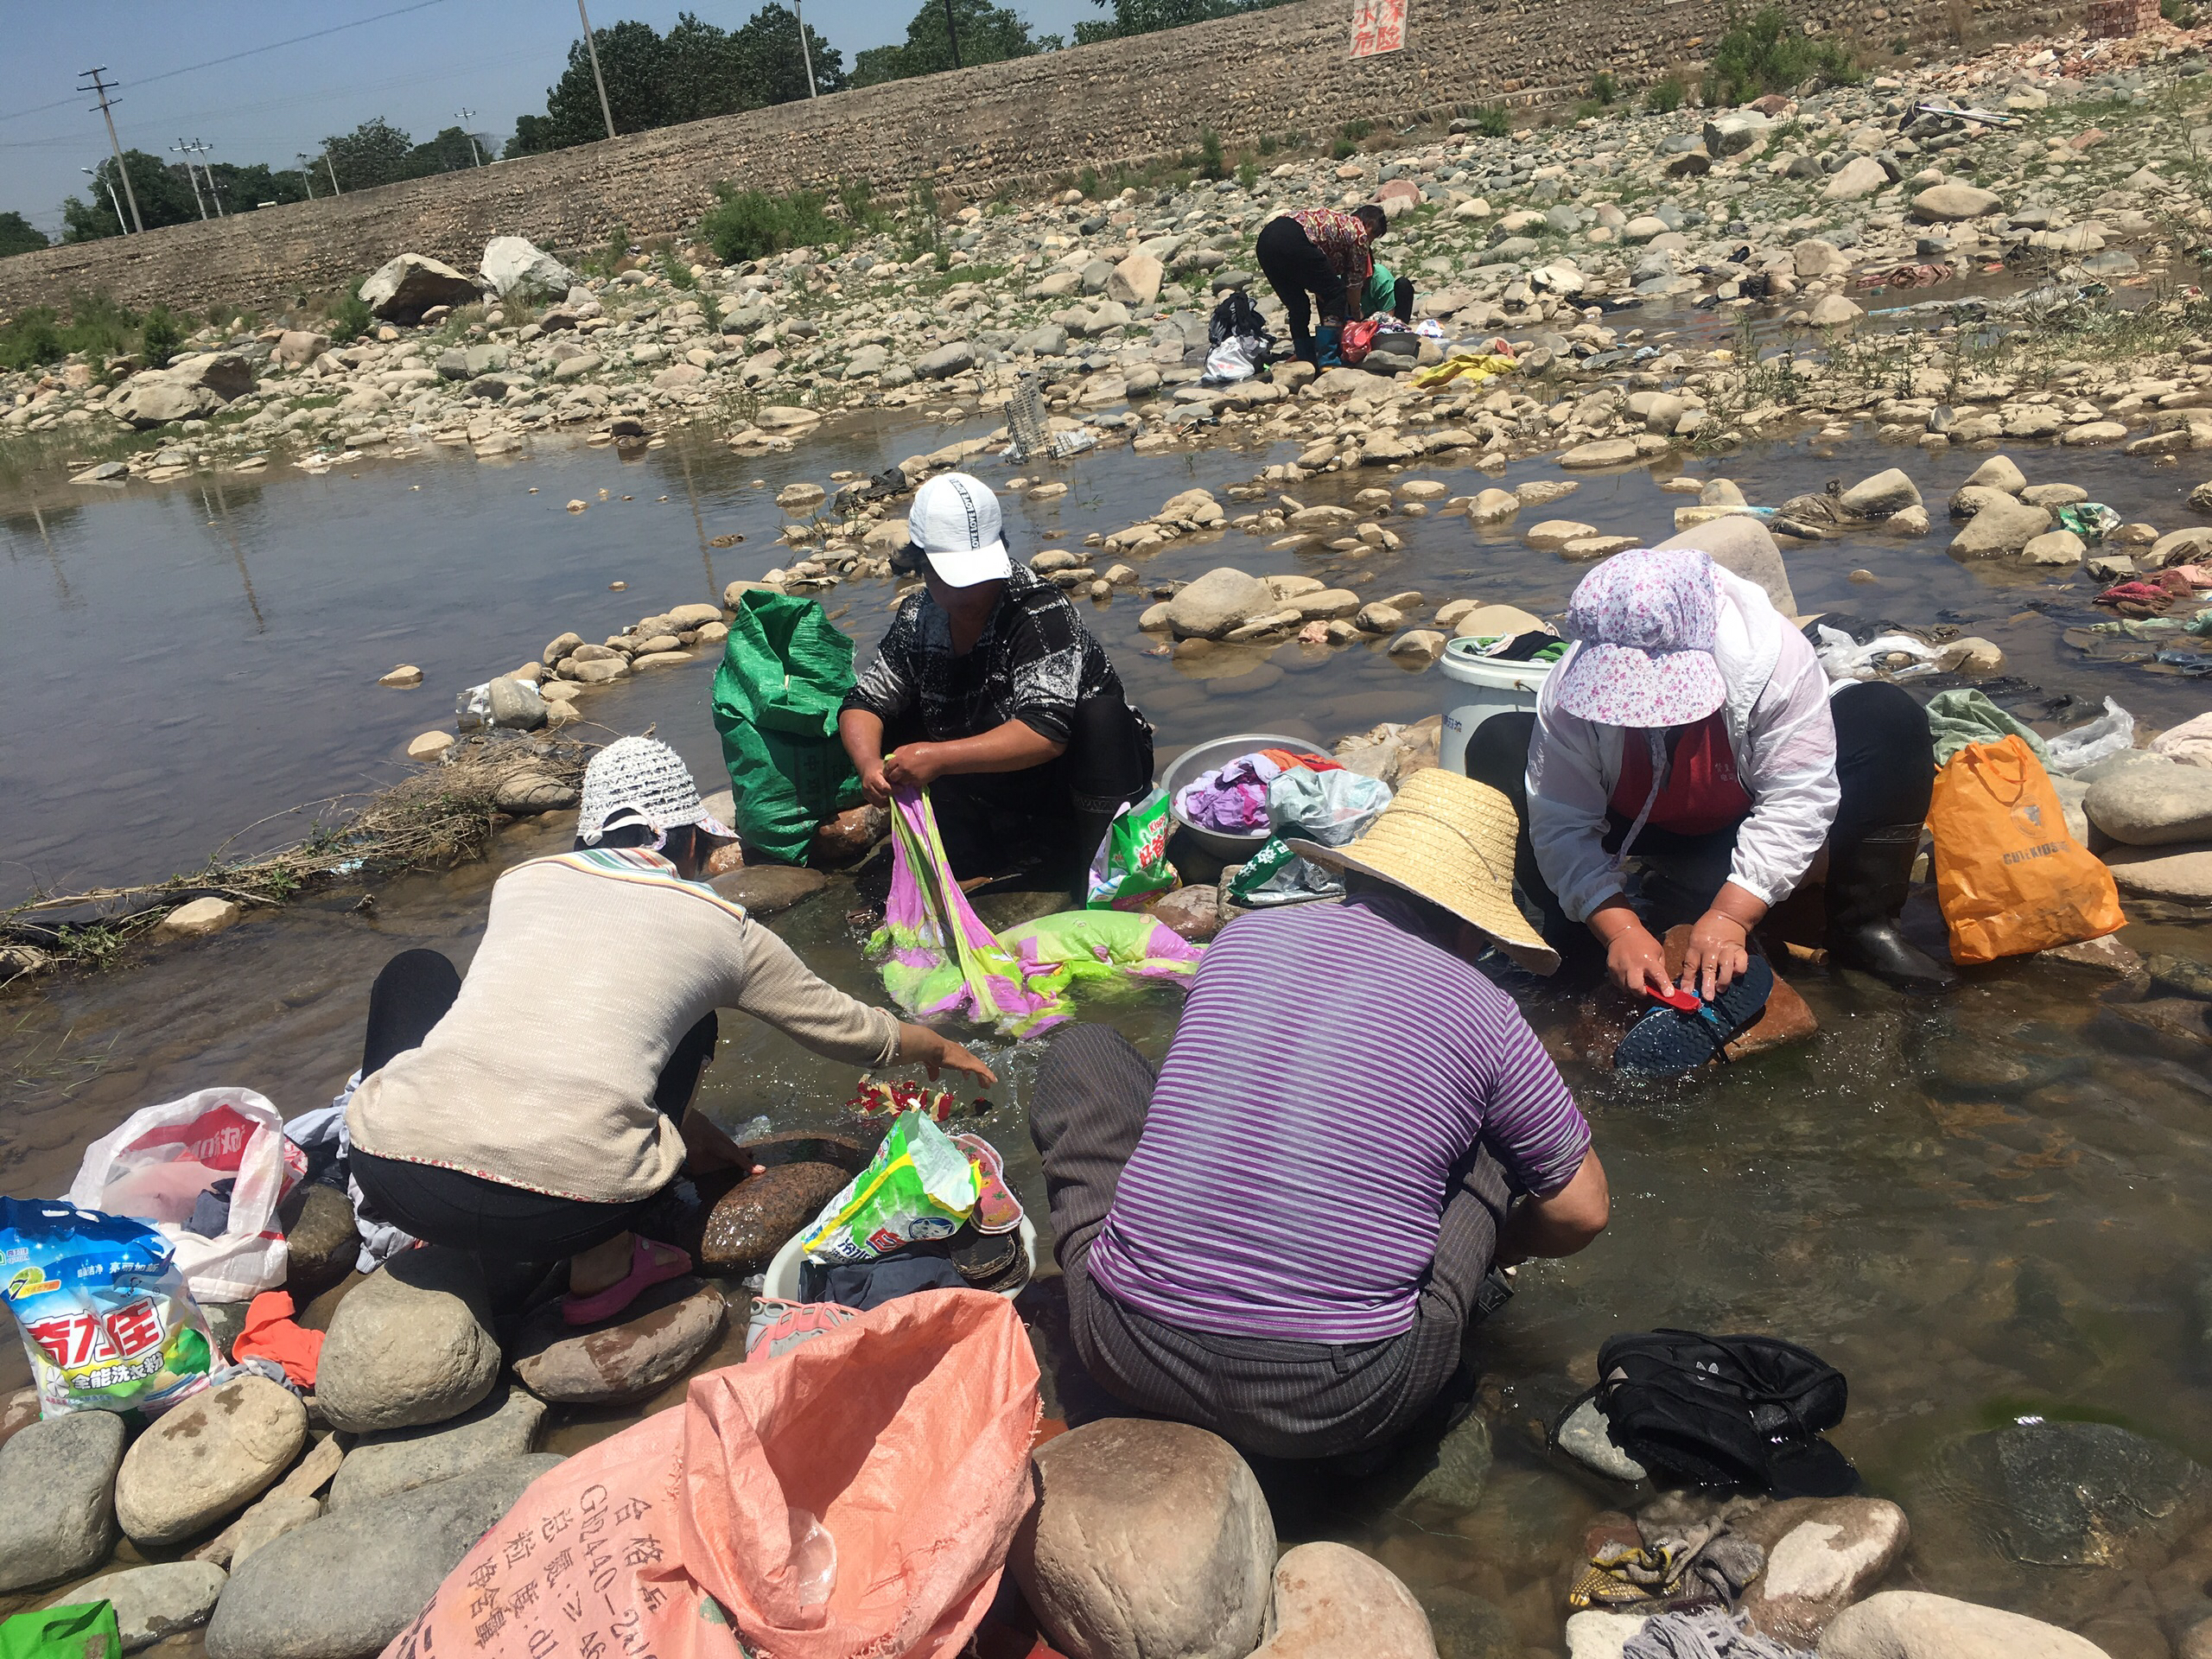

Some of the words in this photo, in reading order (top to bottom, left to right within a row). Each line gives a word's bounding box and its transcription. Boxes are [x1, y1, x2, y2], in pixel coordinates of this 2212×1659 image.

[1350, 24, 1401, 56] 危险
[962, 493, 975, 512] LOVE
[968, 512, 977, 531] LOVE
[9, 1278, 29, 1300] 7
[71, 1351, 165, 1390] 全能洗衣粉
